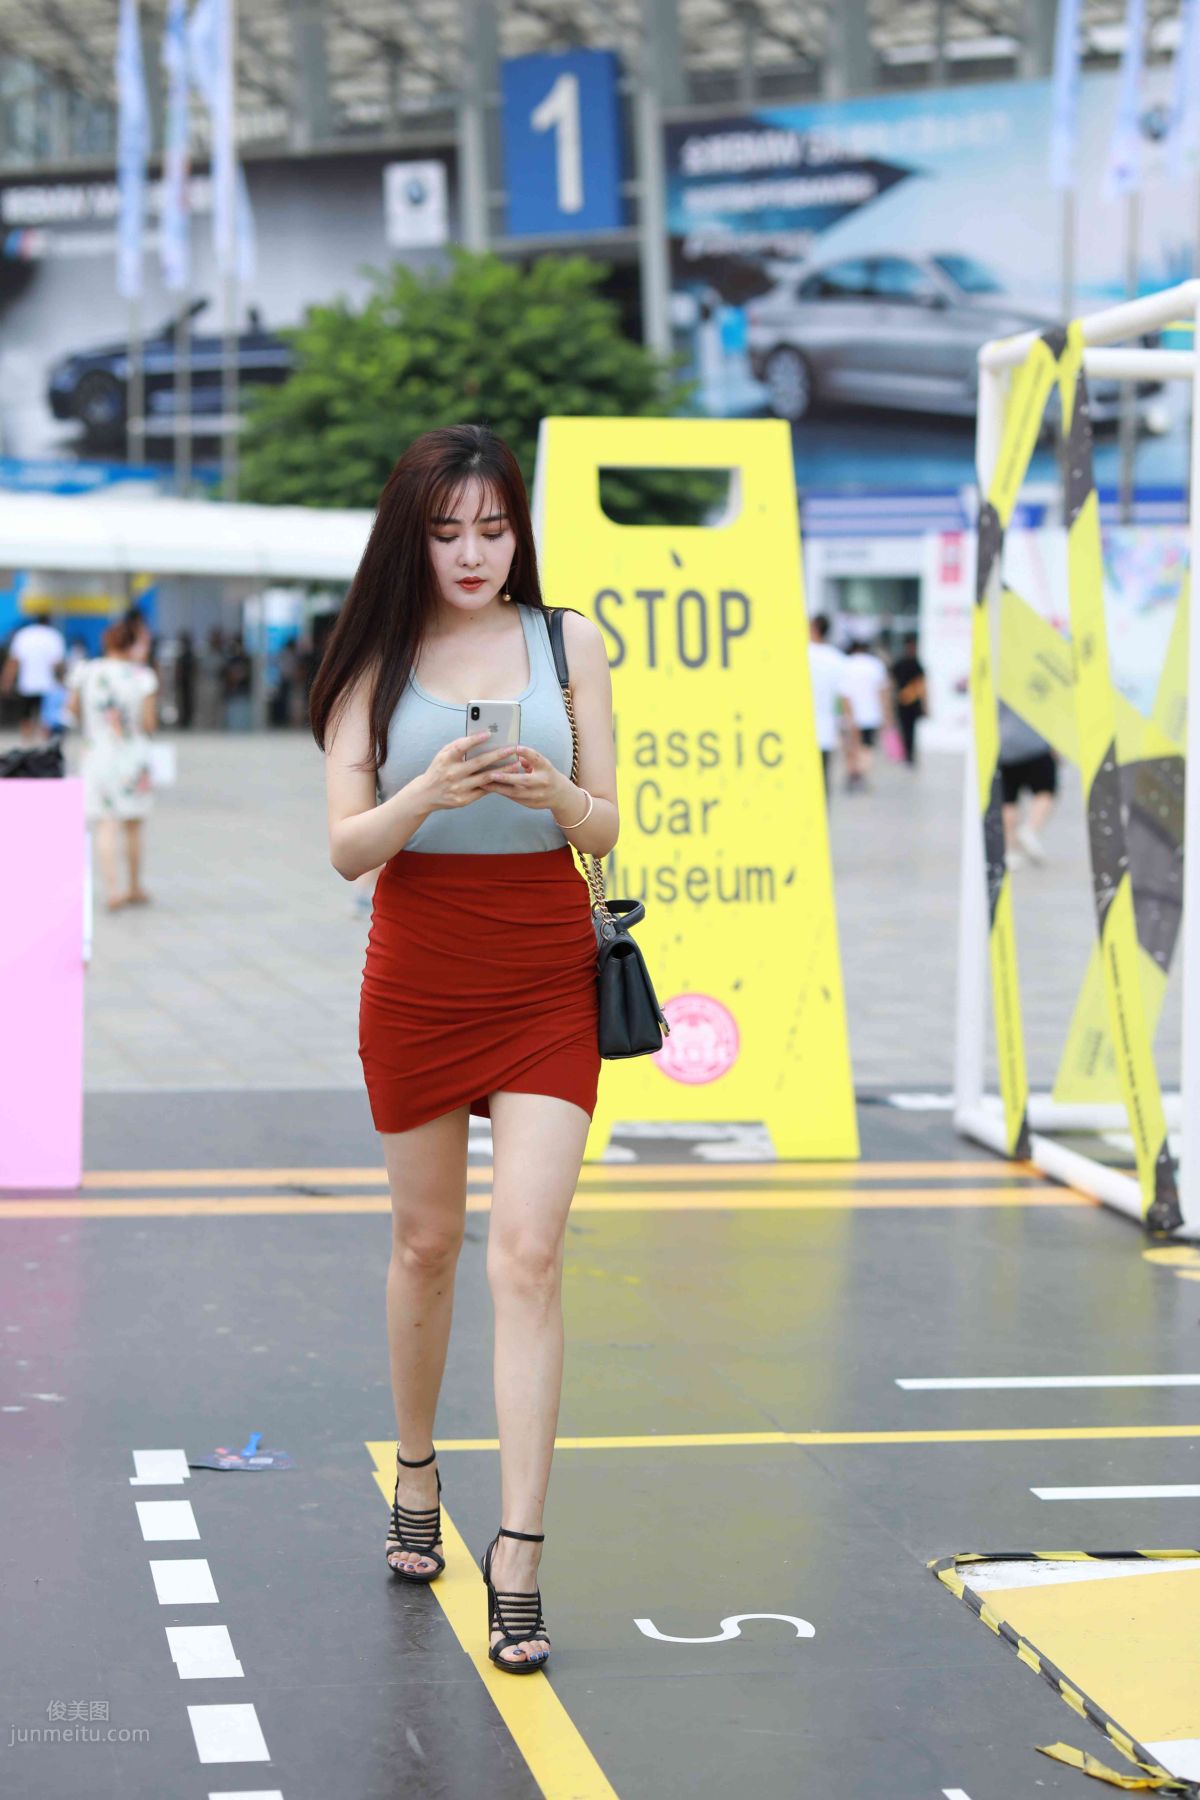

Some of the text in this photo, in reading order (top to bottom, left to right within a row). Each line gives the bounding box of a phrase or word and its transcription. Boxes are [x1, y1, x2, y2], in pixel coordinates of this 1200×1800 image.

[530, 72, 584, 215] 1
[594, 588, 752, 670] STOP
[612, 712, 784, 769] lassic
[635, 779, 720, 836] Car
